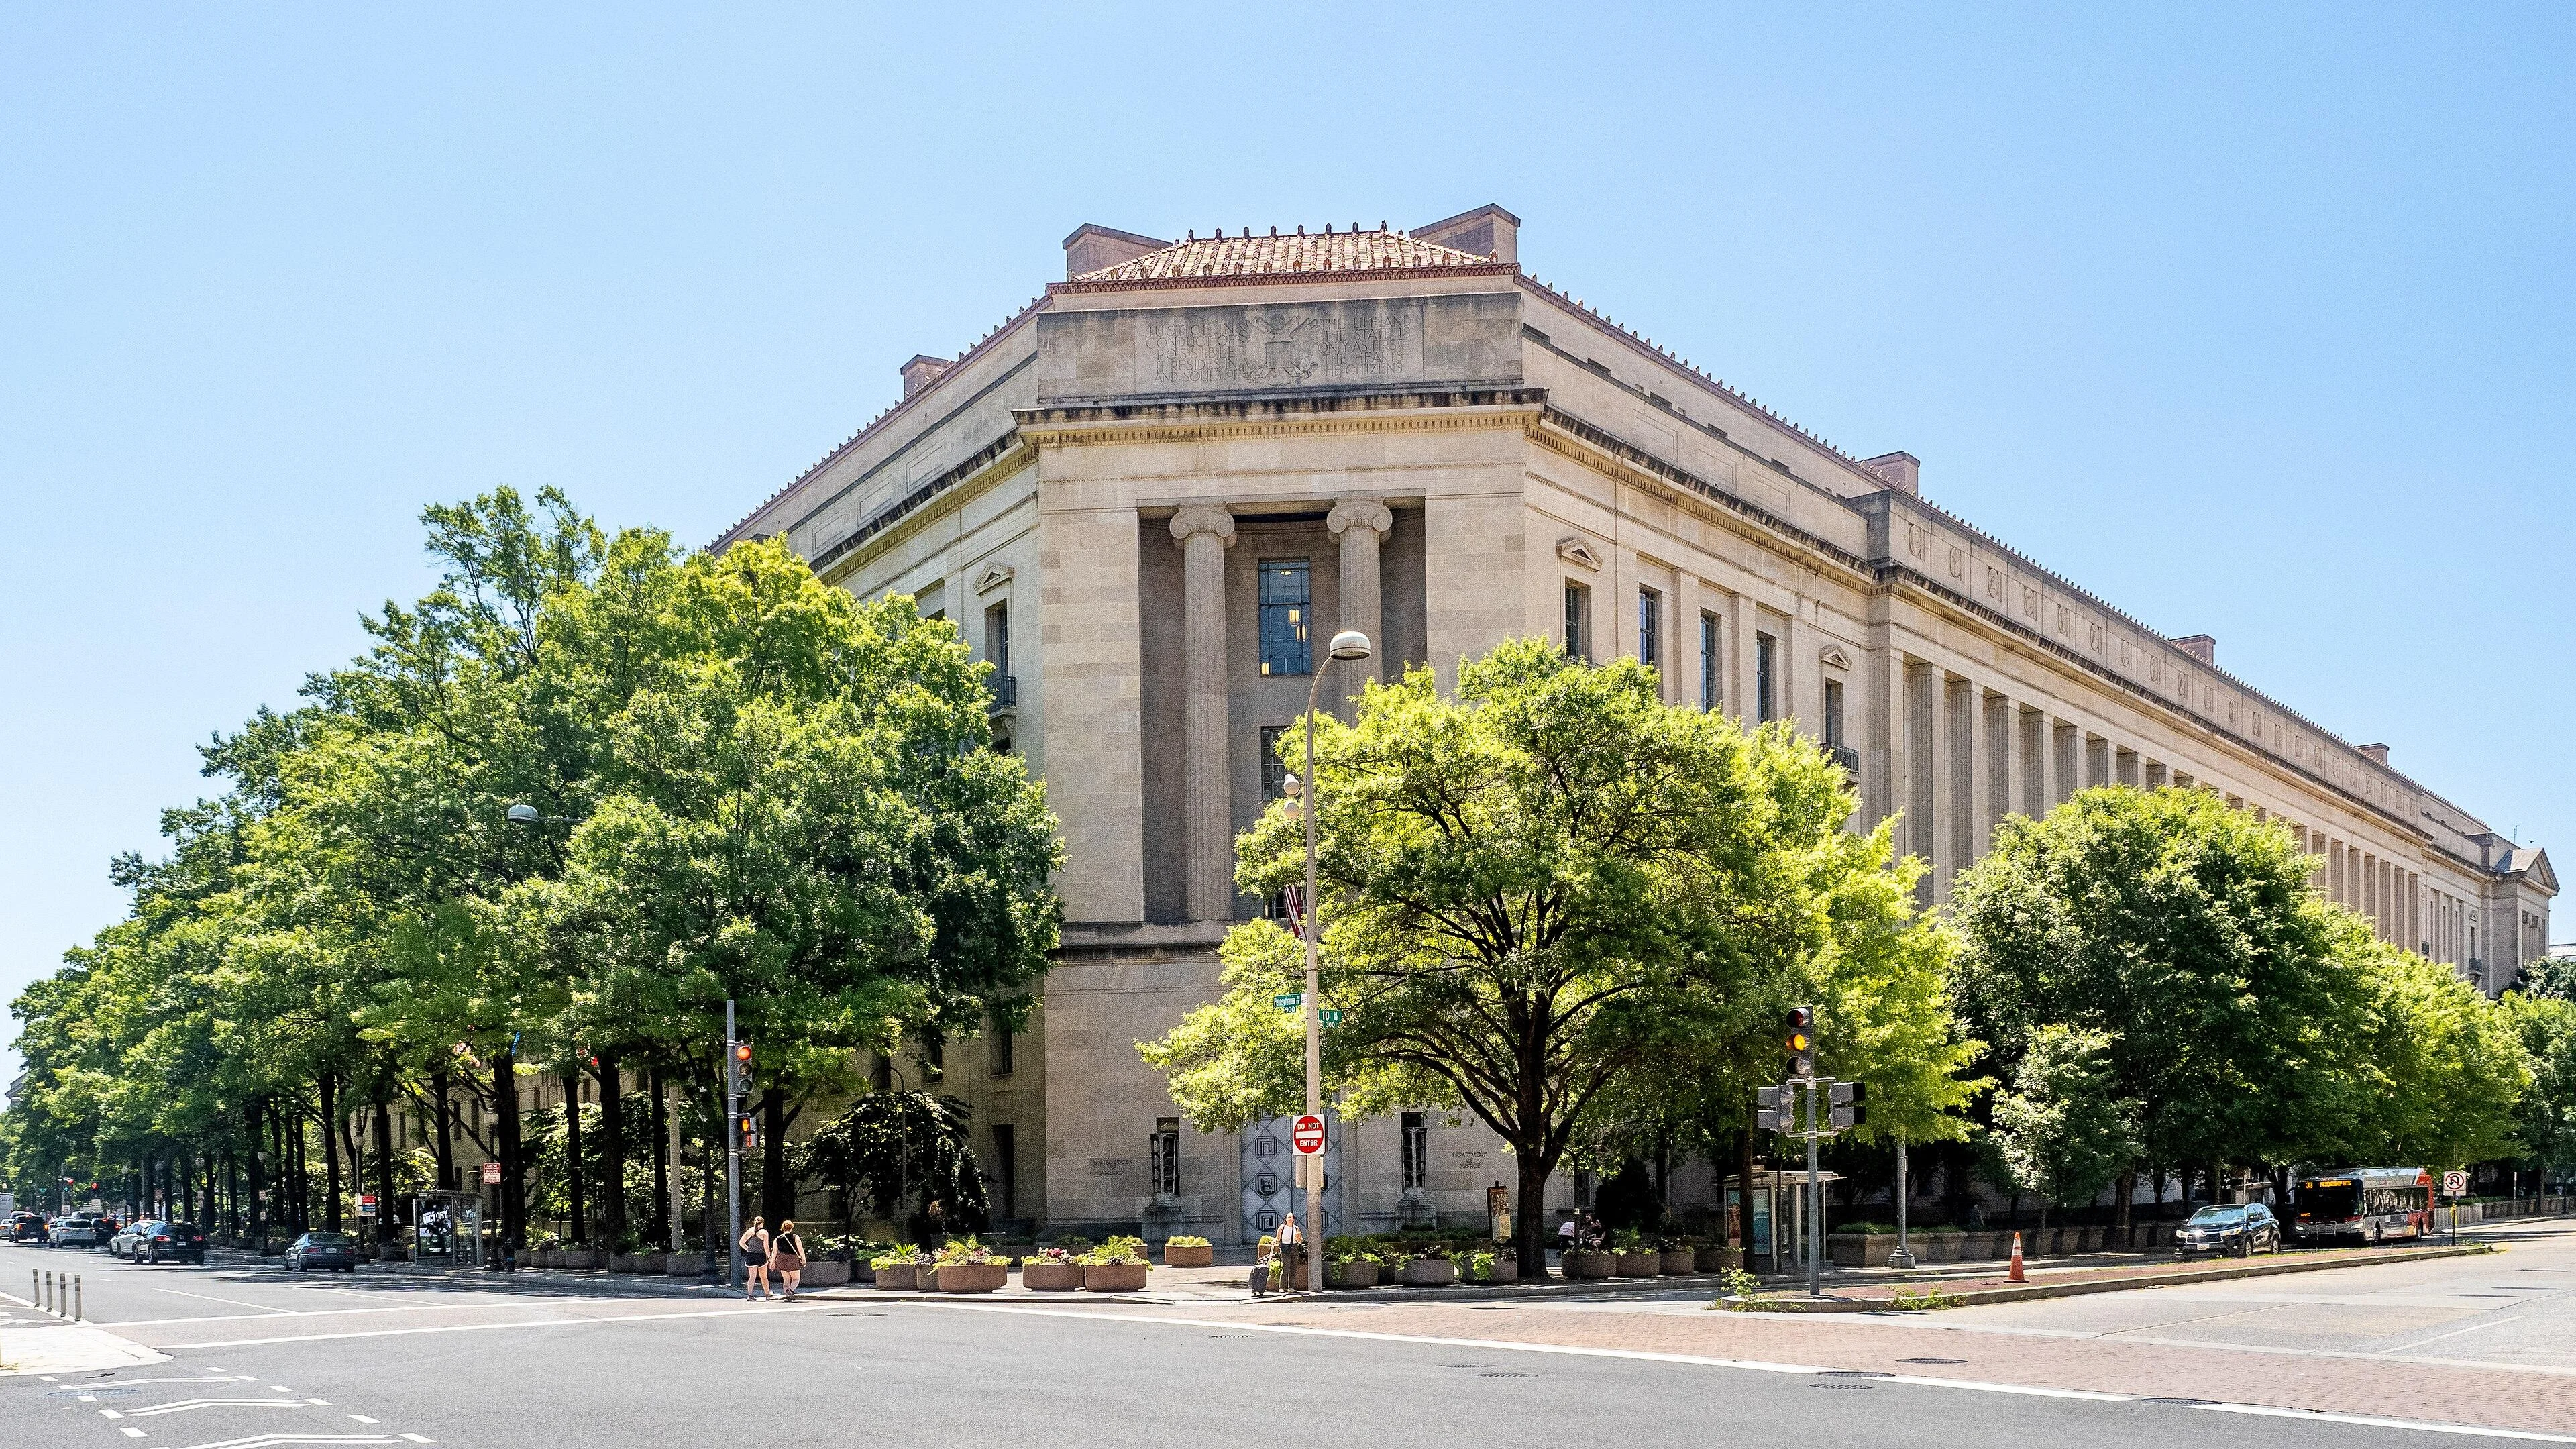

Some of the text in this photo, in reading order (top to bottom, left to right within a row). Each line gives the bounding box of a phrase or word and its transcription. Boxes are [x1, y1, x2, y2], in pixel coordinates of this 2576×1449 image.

[1145, 323, 1234, 337] JUSTICE IN
[1320, 315, 1411, 331] THE LIFE AND
[1146, 334, 1234, 349] CONDUCT OF
[1323, 327, 1410, 342] THE STATE IS
[1157, 345, 1234, 360] POSSIBLE
[1352, 340, 1368, 352] AS
[1373, 339, 1403, 351] FIRST
[1157, 357, 1237, 372] IT RESIDES IN
[1324, 350, 1403, 366] THE HEARTS
[1155, 369, 1240, 383] AND SOULS OF
[1320, 362, 1403, 377] THE CITIZENS
[1274, 996, 1295, 1007] Pennsylvania
[1322, 1011, 1330, 1020] 10
[423, 1210, 448, 1225] VICTORY
